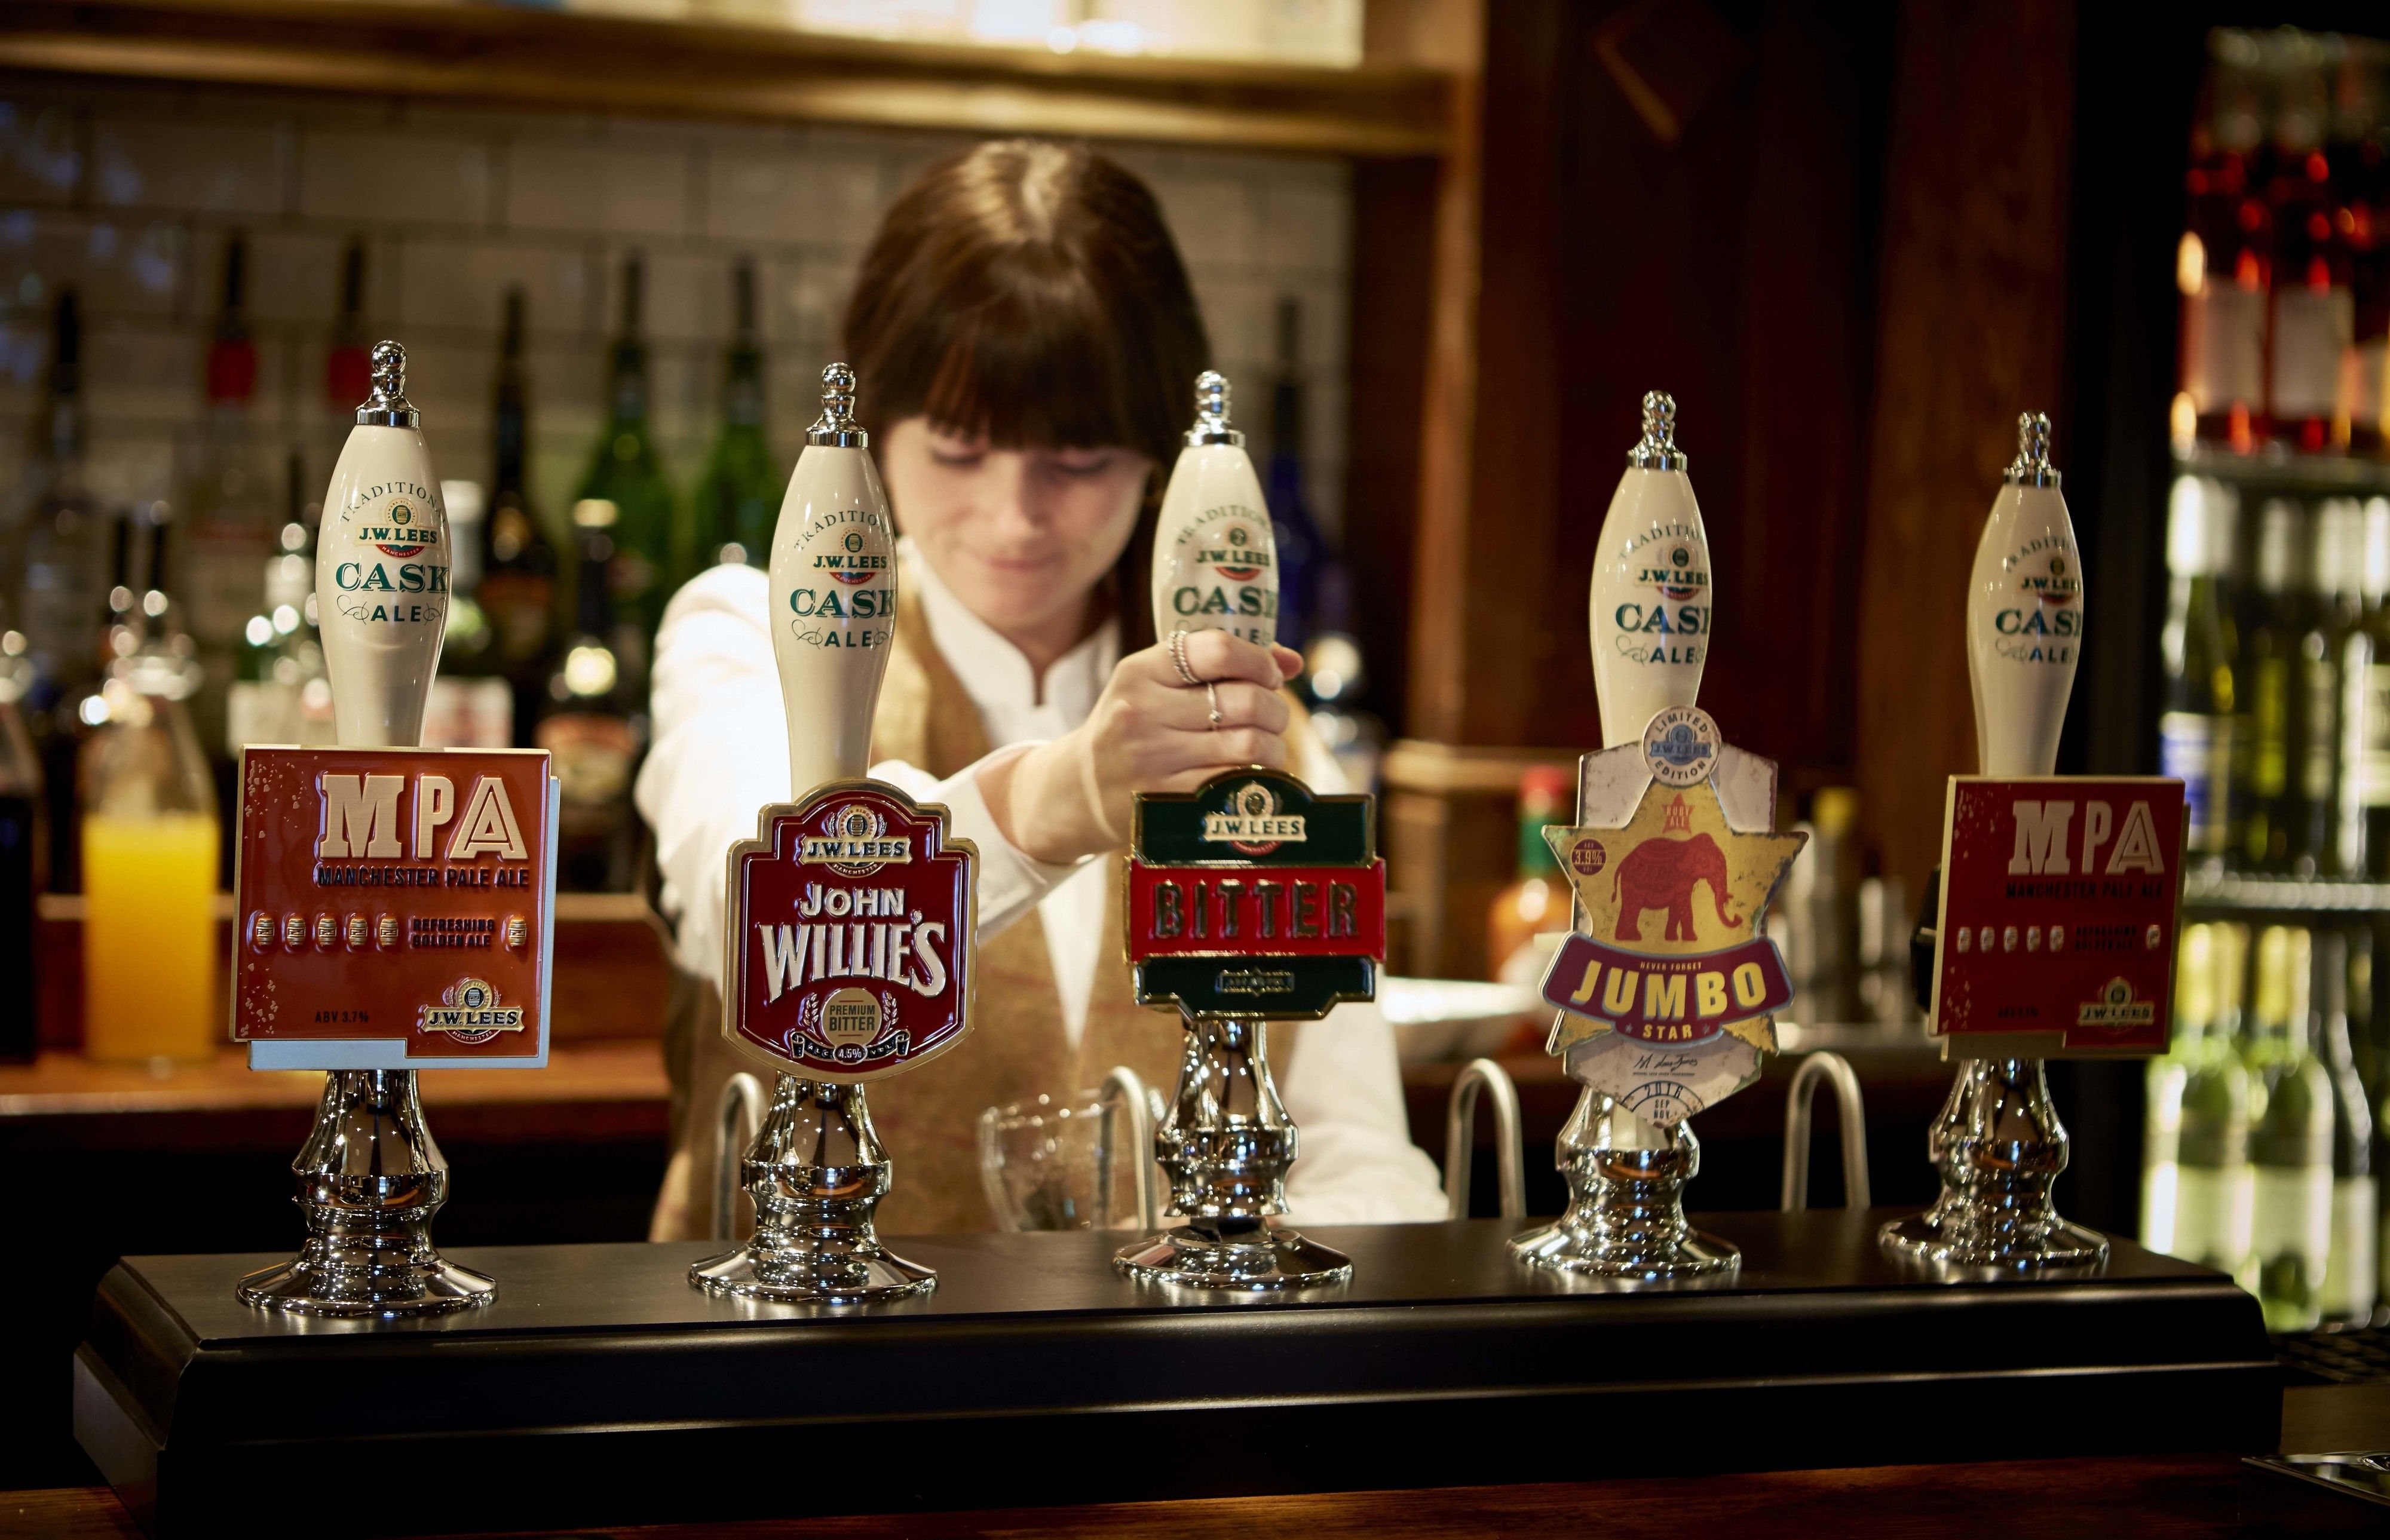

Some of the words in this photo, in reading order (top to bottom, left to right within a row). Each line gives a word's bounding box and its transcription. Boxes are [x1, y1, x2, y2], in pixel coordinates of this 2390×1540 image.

[340, 481, 446, 523] TRADITIONA
[382, 546, 420, 556] MANCHESTER
[336, 563, 449, 593] CASK
[370, 605, 421, 622] ALE
[824, 631, 872, 648] ALE
[1650, 646, 1695, 665] ALE
[1654, 711, 1708, 732] LIMITED
[1654, 760, 1706, 780] EDITION
[320, 774, 529, 860] MPA
[2008, 800, 2165, 876] MPA
[1575, 850, 1602, 865] 3.9%
[317, 866, 439, 887] MANCHESTER
[447, 866, 489, 887] PALE
[497, 867, 529, 887] ALE
[834, 864, 878, 875] MANCHESTER
[2005, 881, 2097, 898] MANCHESTER
[2102, 880, 2134, 898] PALE
[2140, 880, 2164, 897] ALE
[798, 883, 905, 918] JOHN
[1154, 879, 1359, 938] BITTER
[413, 918, 494, 931] REFRESHING
[413, 934, 463, 947] GOLDEN
[466, 934, 491, 947] ALE
[758, 909, 946, 1003] WILLIE'S
[1640, 961, 1667, 971] NEVER
[1671, 961, 1702, 972] FORGET
[1570, 959, 1767, 1020] JUMBO
[315, 1011, 338, 1023] ABV
[342, 1011, 369, 1023] 3.7%
[829, 1004, 876, 1016] PREMIUM
[829, 1017, 875, 1031] BITTER
[1643, 1023, 1693, 1041] STAR
[452, 1030, 493, 1042] MANCHESTER
[808, 1044, 829, 1056] ALC
[838, 1048, 862, 1059] 4.5%
[871, 1044, 893, 1056] VOL
